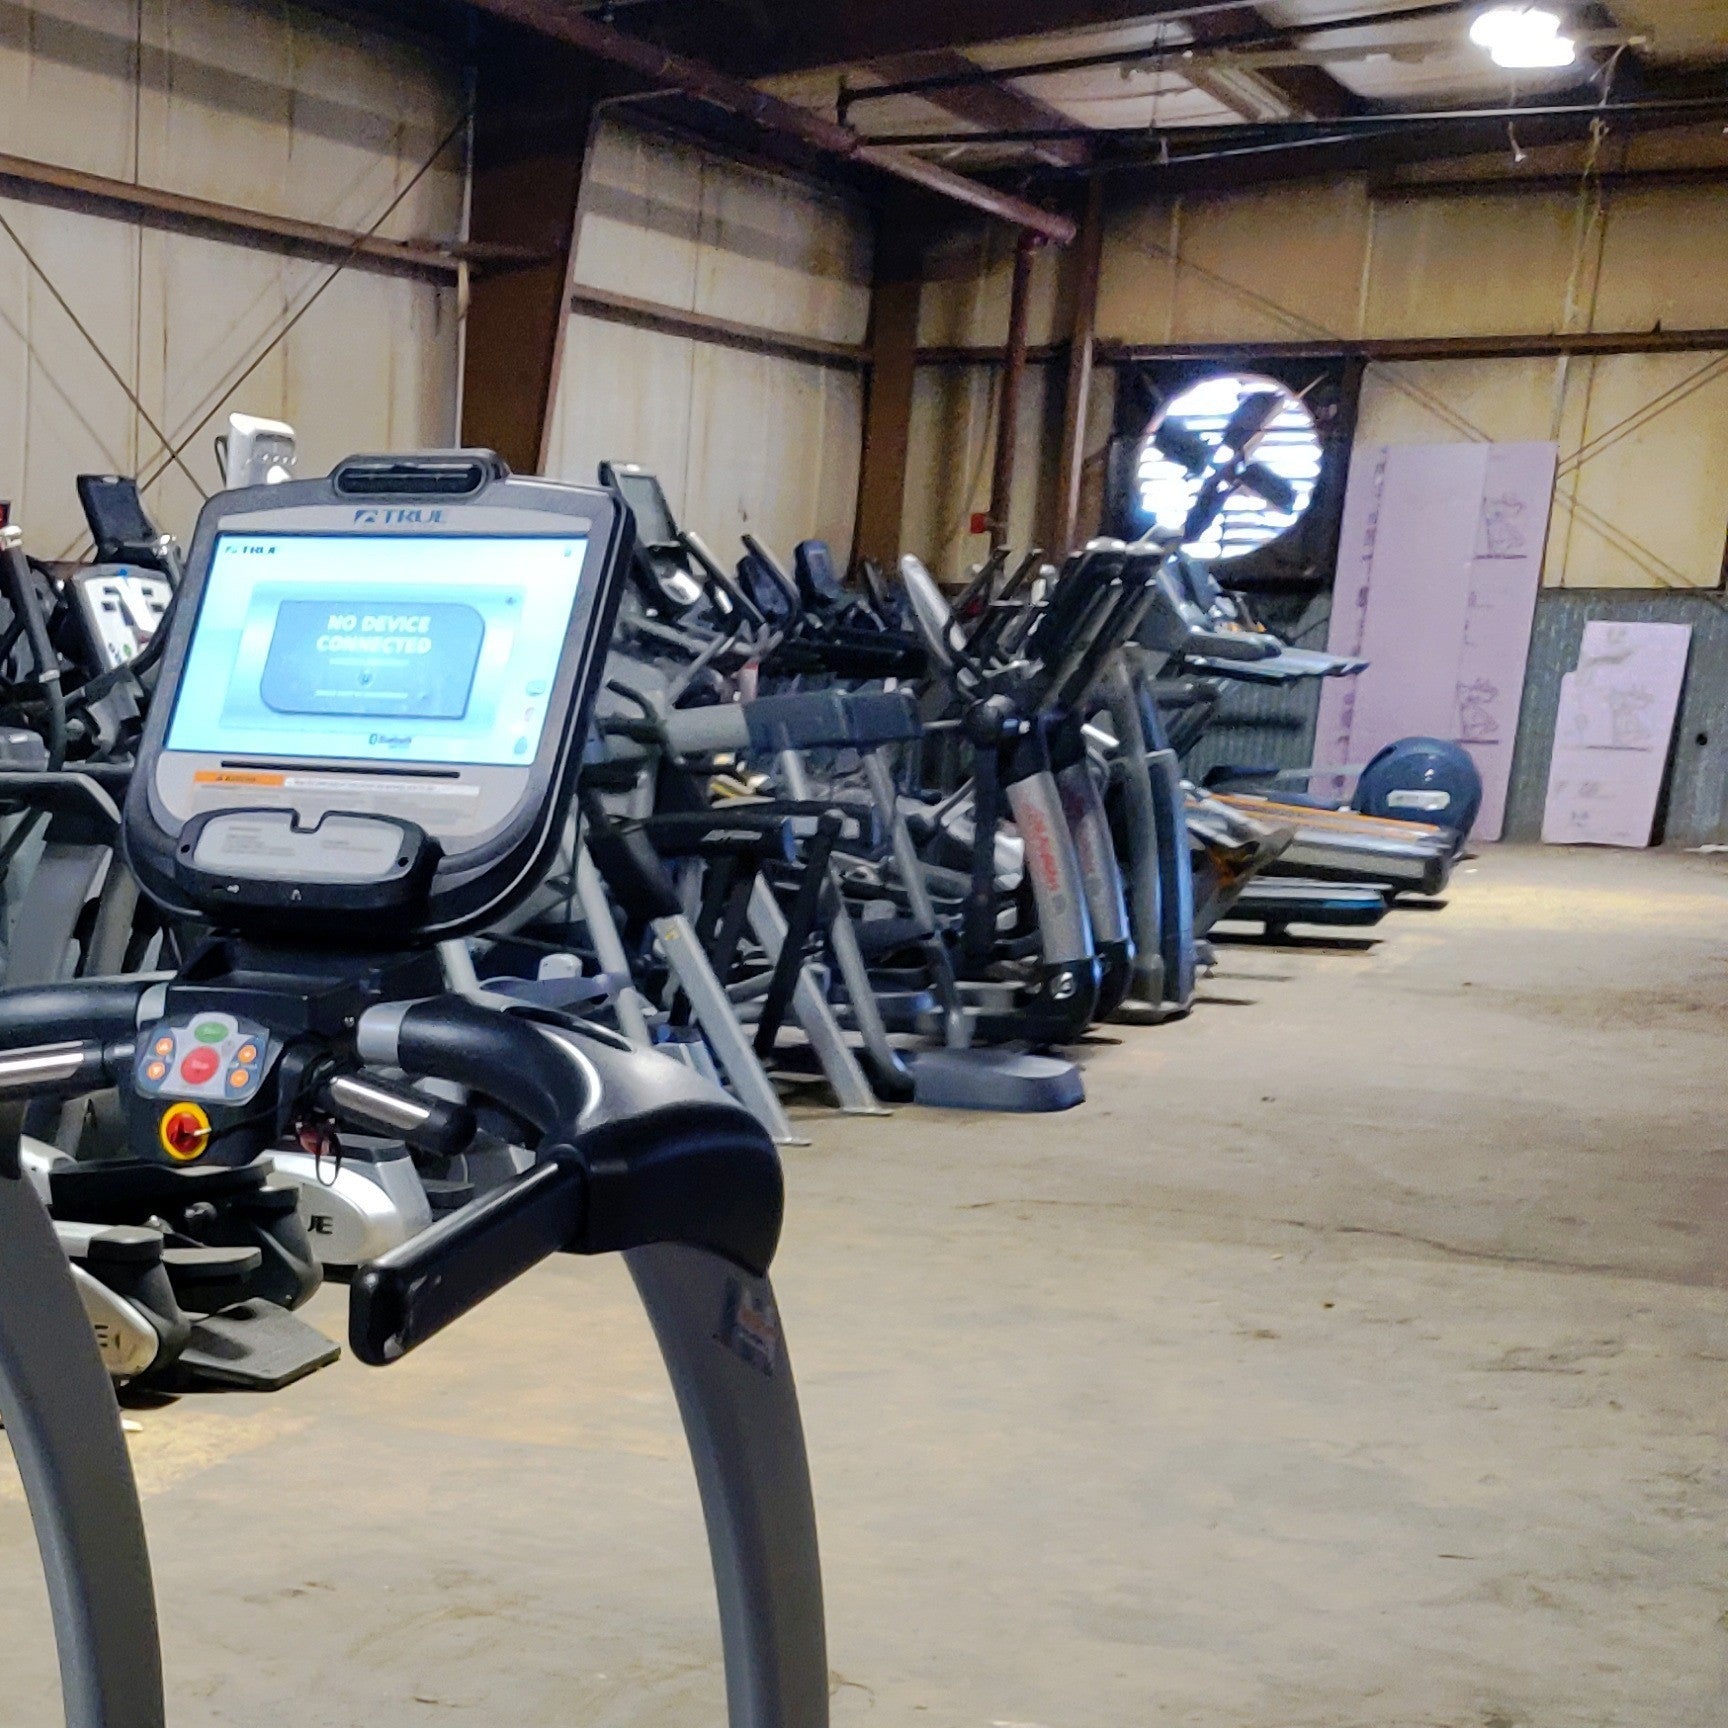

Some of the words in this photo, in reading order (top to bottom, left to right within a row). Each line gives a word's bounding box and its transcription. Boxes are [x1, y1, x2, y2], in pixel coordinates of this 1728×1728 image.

[383, 509, 445, 523] TRUE
[327, 615, 356, 632] NO
[361, 615, 432, 633] DEVICE
[316, 635, 433, 654] CONNECTED
